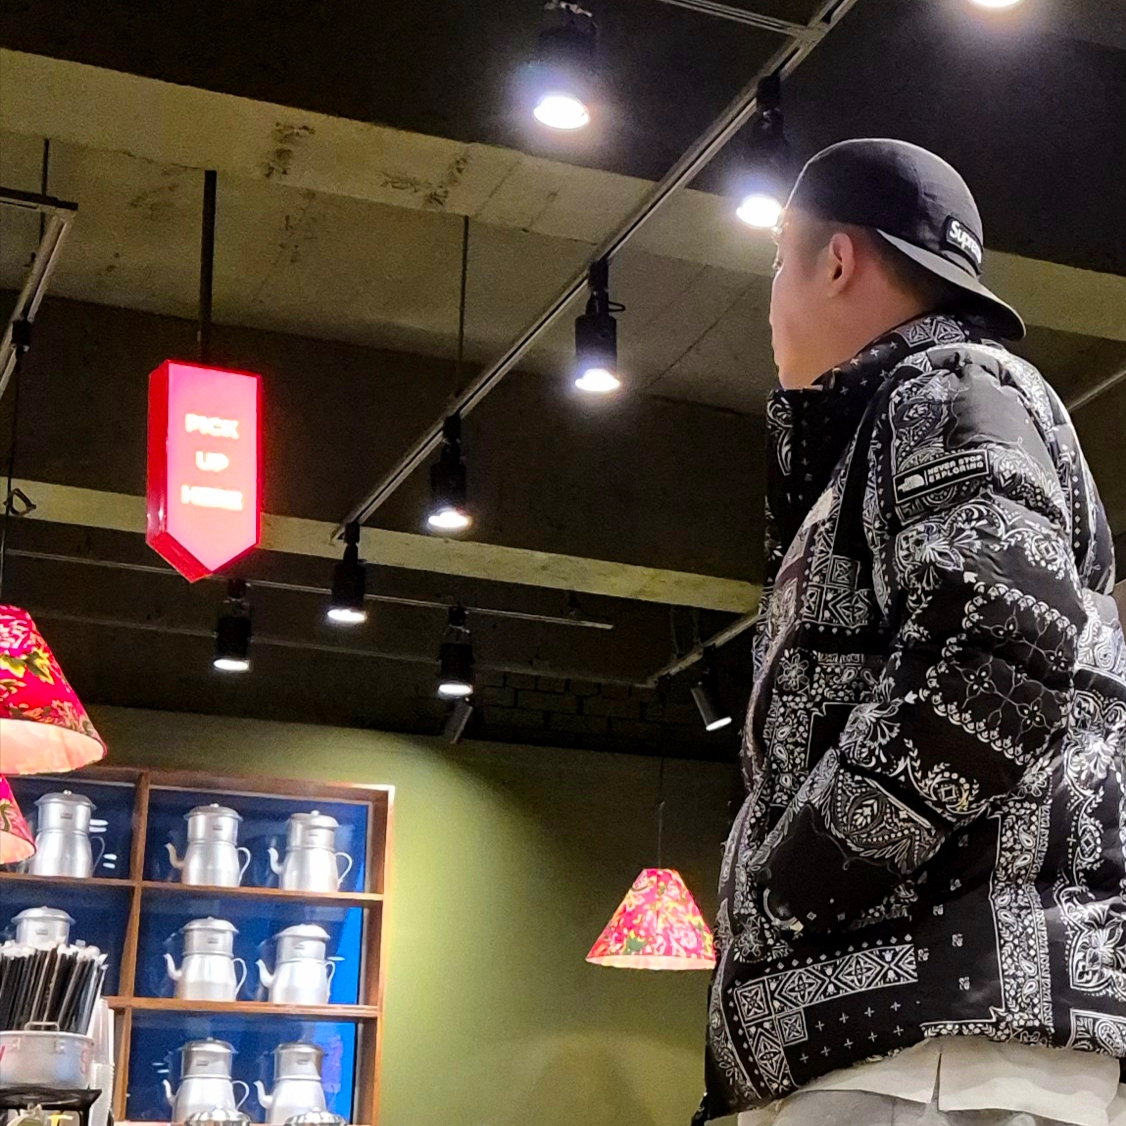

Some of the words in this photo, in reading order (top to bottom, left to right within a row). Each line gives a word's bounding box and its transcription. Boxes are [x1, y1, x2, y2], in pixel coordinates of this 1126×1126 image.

[185, 413, 239, 440] PICK
[195, 450, 229, 473] UP
[927, 460, 956, 476] NEVER
[958, 454, 982, 466] STOP
[929, 461, 984, 483] EXPLORING
